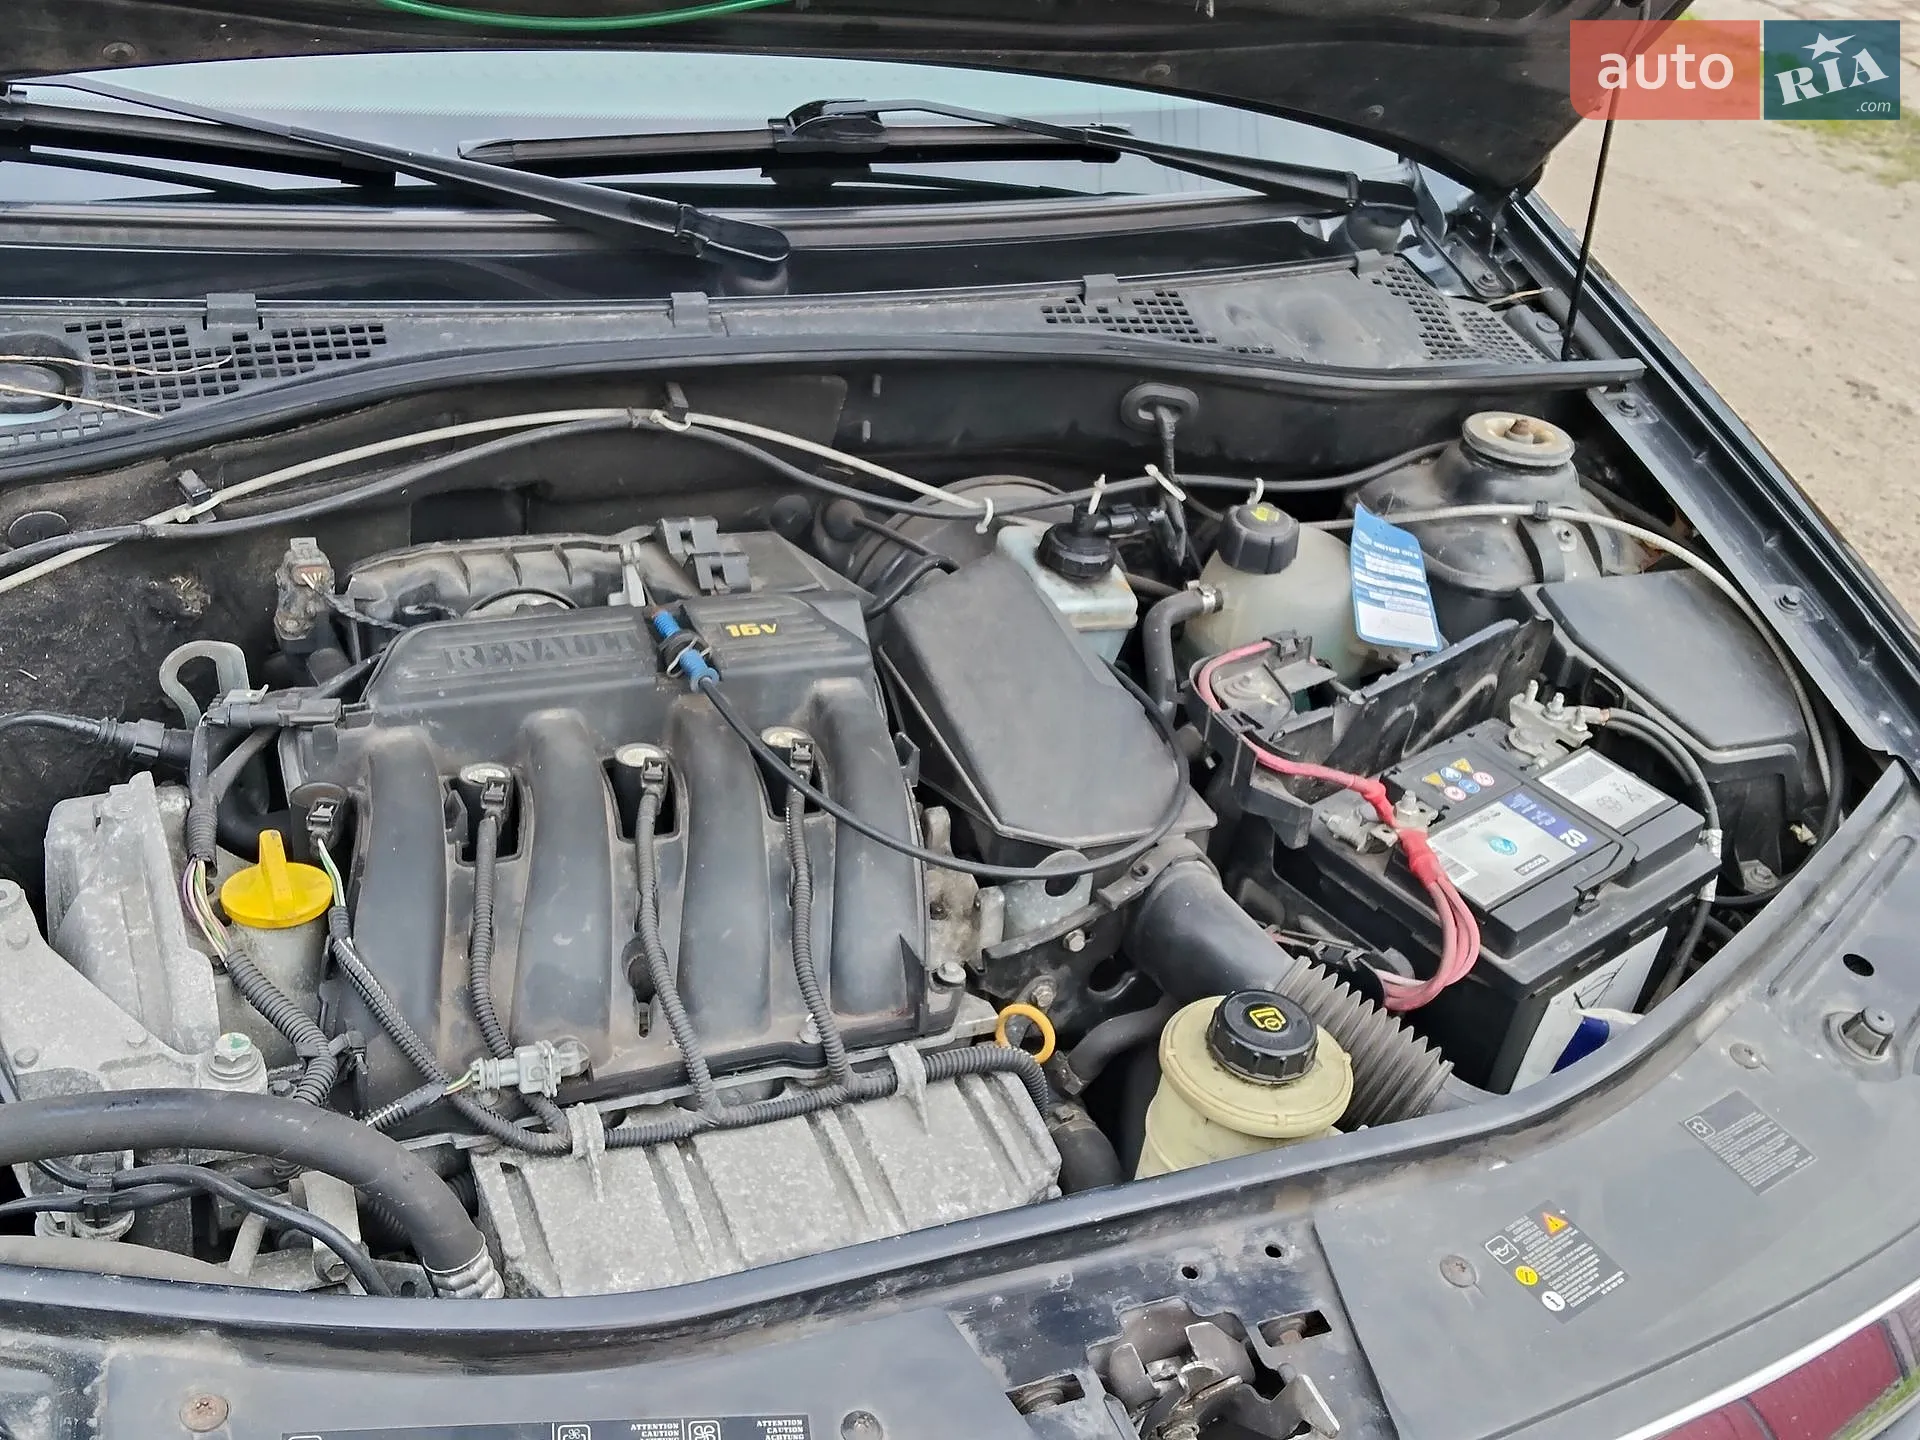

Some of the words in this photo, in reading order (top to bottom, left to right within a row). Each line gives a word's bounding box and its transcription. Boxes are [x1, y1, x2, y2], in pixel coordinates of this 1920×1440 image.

[448, 629, 638, 671] RENAULT
[630, 1423, 679, 1431] ATTENTION
[757, 1419, 803, 1427] ATTENTION
[766, 1426, 804, 1434] CAUTION
